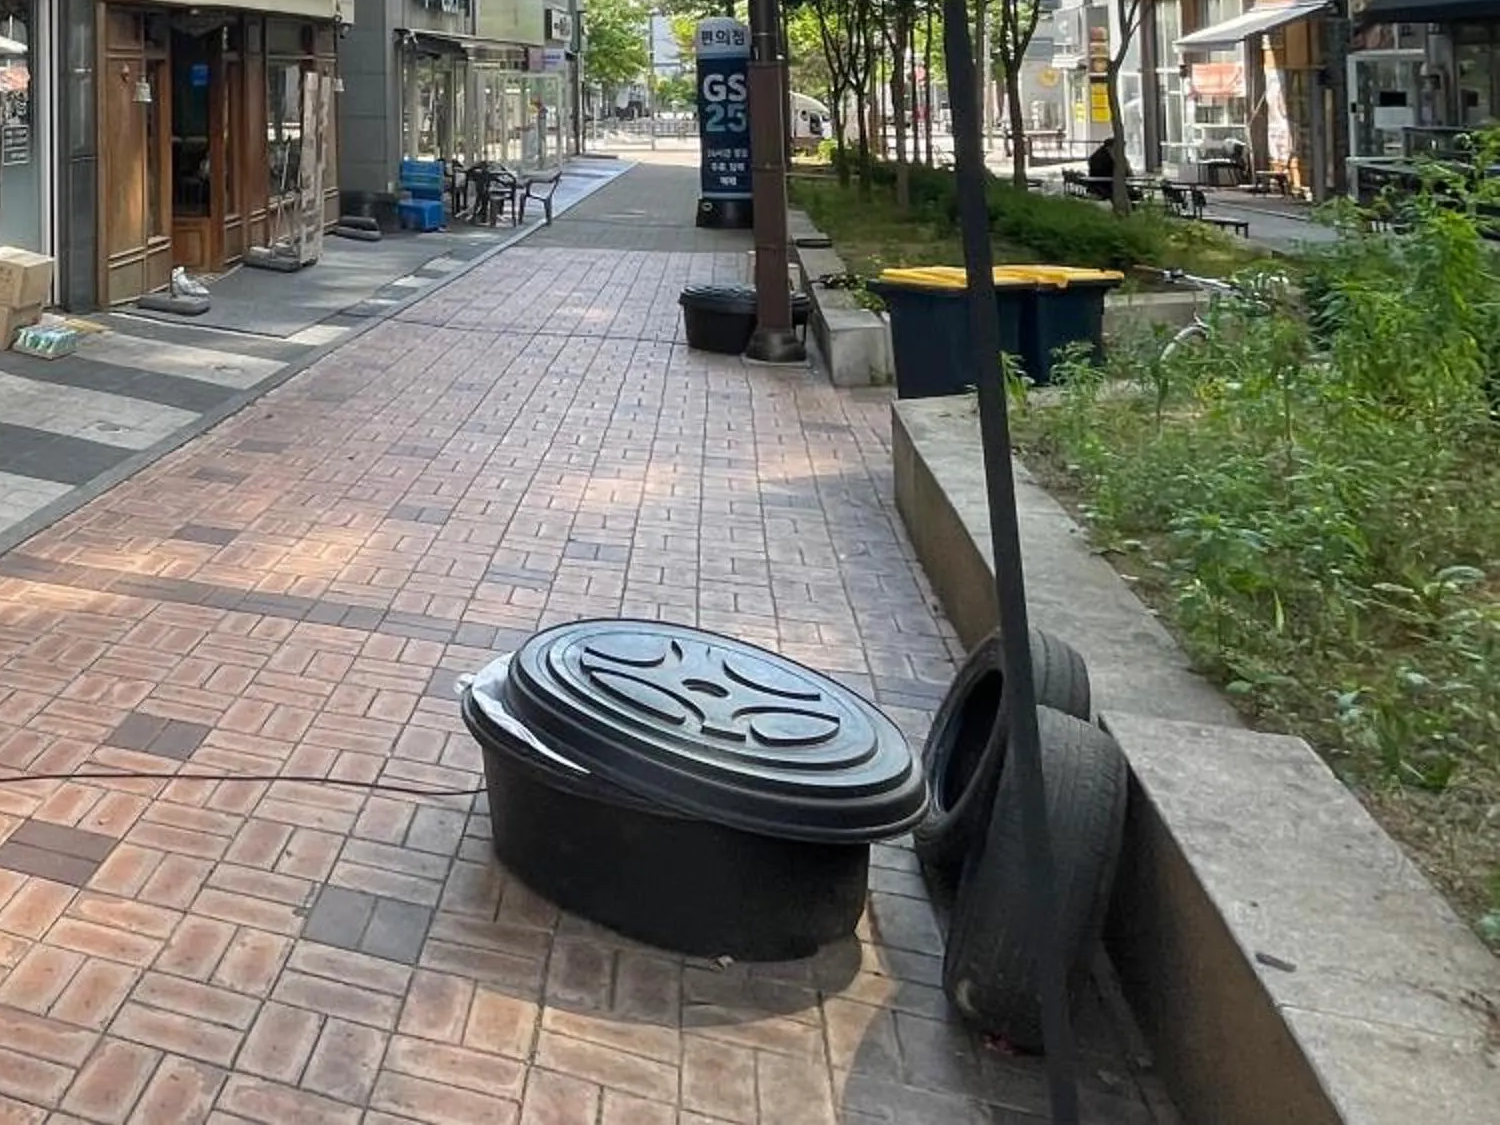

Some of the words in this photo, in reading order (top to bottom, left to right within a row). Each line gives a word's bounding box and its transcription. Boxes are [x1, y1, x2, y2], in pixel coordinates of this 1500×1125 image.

[701, 30, 745, 46] 편의점
[703, 74, 747, 102] GS
[705, 104, 747, 133] 25
